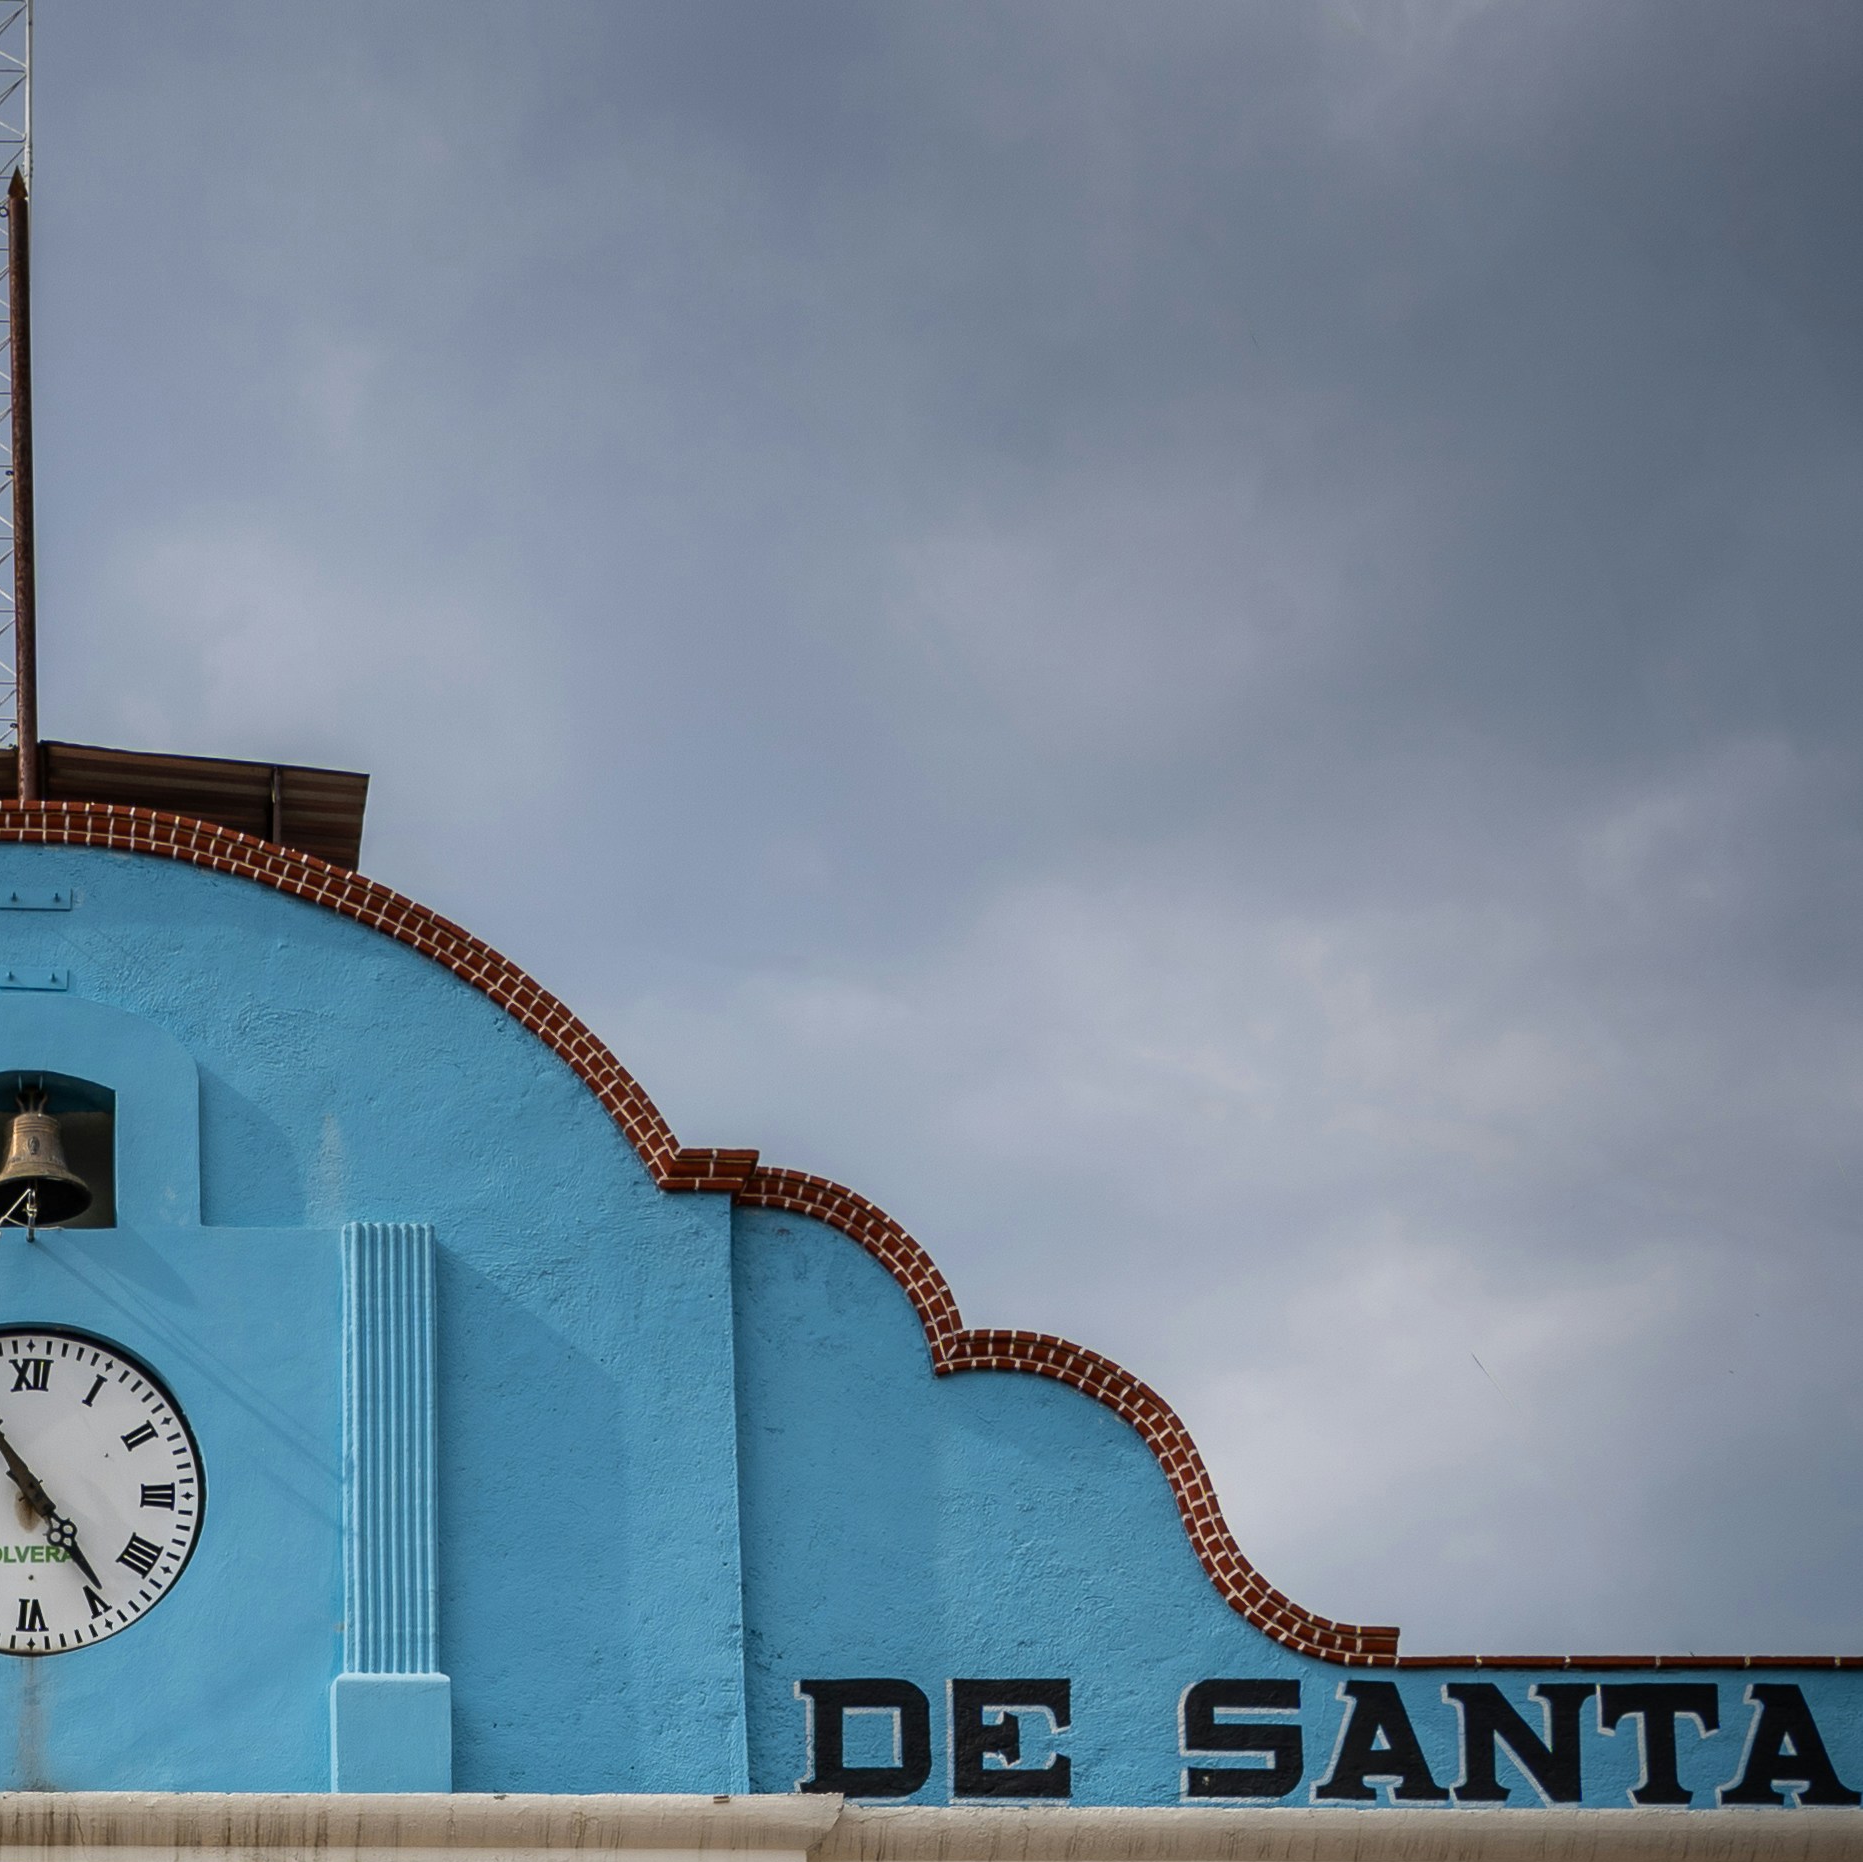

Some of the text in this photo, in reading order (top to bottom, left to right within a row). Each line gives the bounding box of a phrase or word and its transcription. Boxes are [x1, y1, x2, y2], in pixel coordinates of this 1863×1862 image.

[9, 1359, 54, 1392] XII
[82, 1375, 108, 1407] I
[121, 1420, 159, 1452] II
[140, 1483, 175, 1510] III
[116, 1532, 164, 1579] IIII
[16, 1598, 49, 1632] VI
[83, 1585, 112, 1619] V
[794, 1677, 1072, 1802] DE
[1180, 1678, 1863, 1806] SANTA
